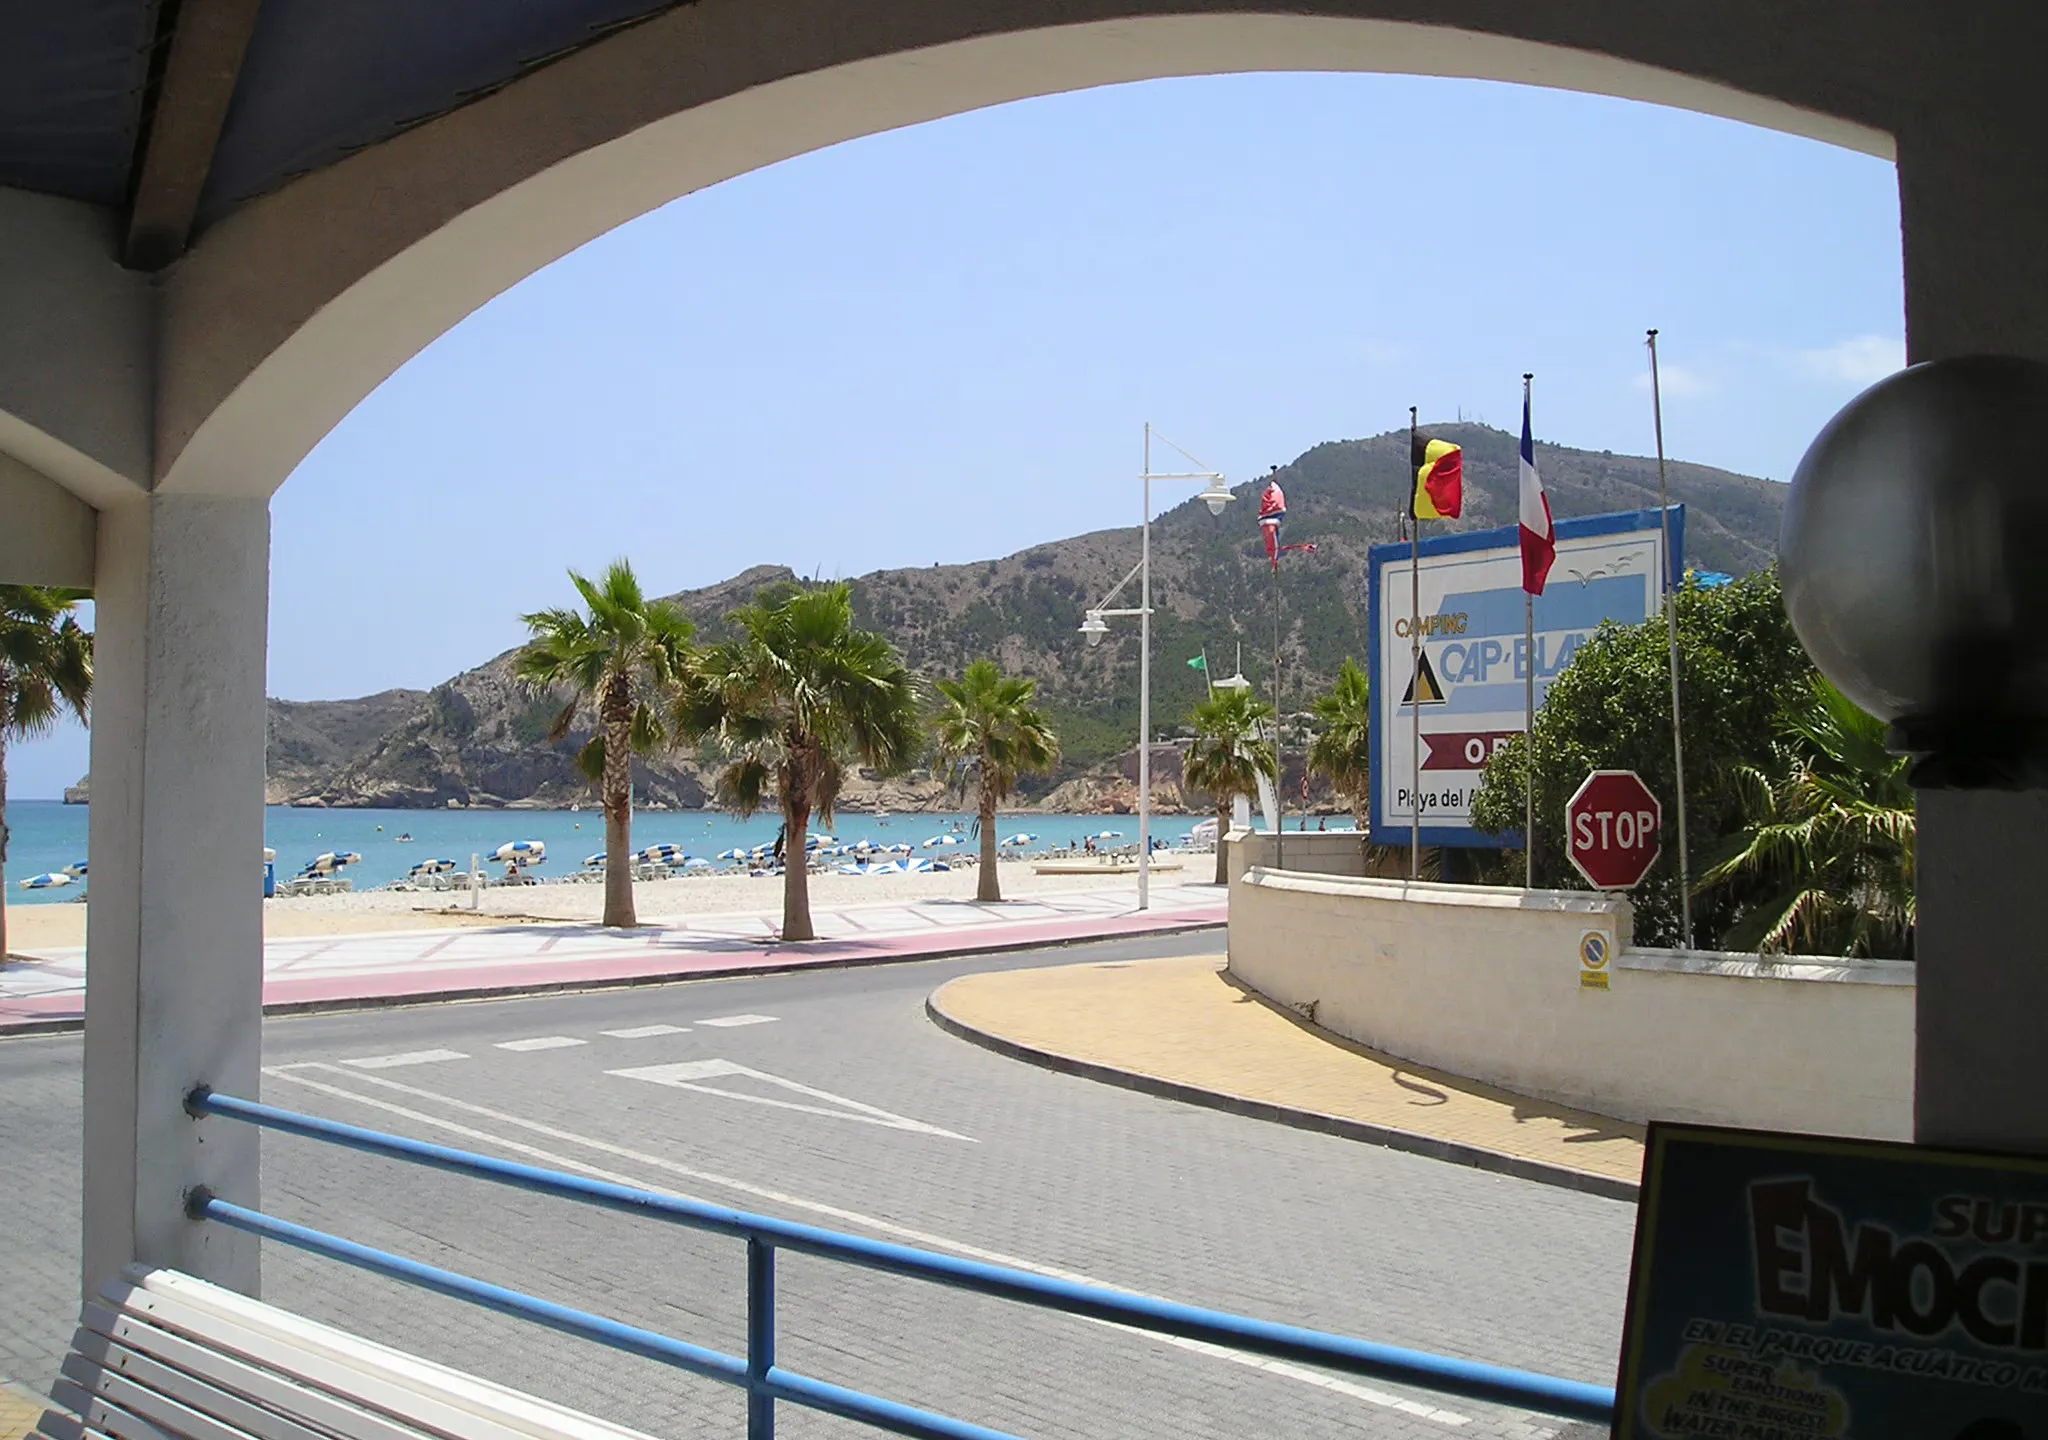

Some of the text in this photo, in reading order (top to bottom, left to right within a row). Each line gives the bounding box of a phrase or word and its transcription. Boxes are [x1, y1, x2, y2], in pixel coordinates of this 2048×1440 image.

[1395, 612, 1469, 638] CAMPING
[1440, 632, 1588, 683] CAP'BLA
[1441, 788, 1463, 807] del
[1575, 811, 1655, 850] STOP
[1685, 1319, 1723, 1342] EN
[1726, 1324, 1754, 1347] EL
[1755, 1329, 1868, 1364] PARQUE
[1701, 1354, 1775, 1381] SUPER
